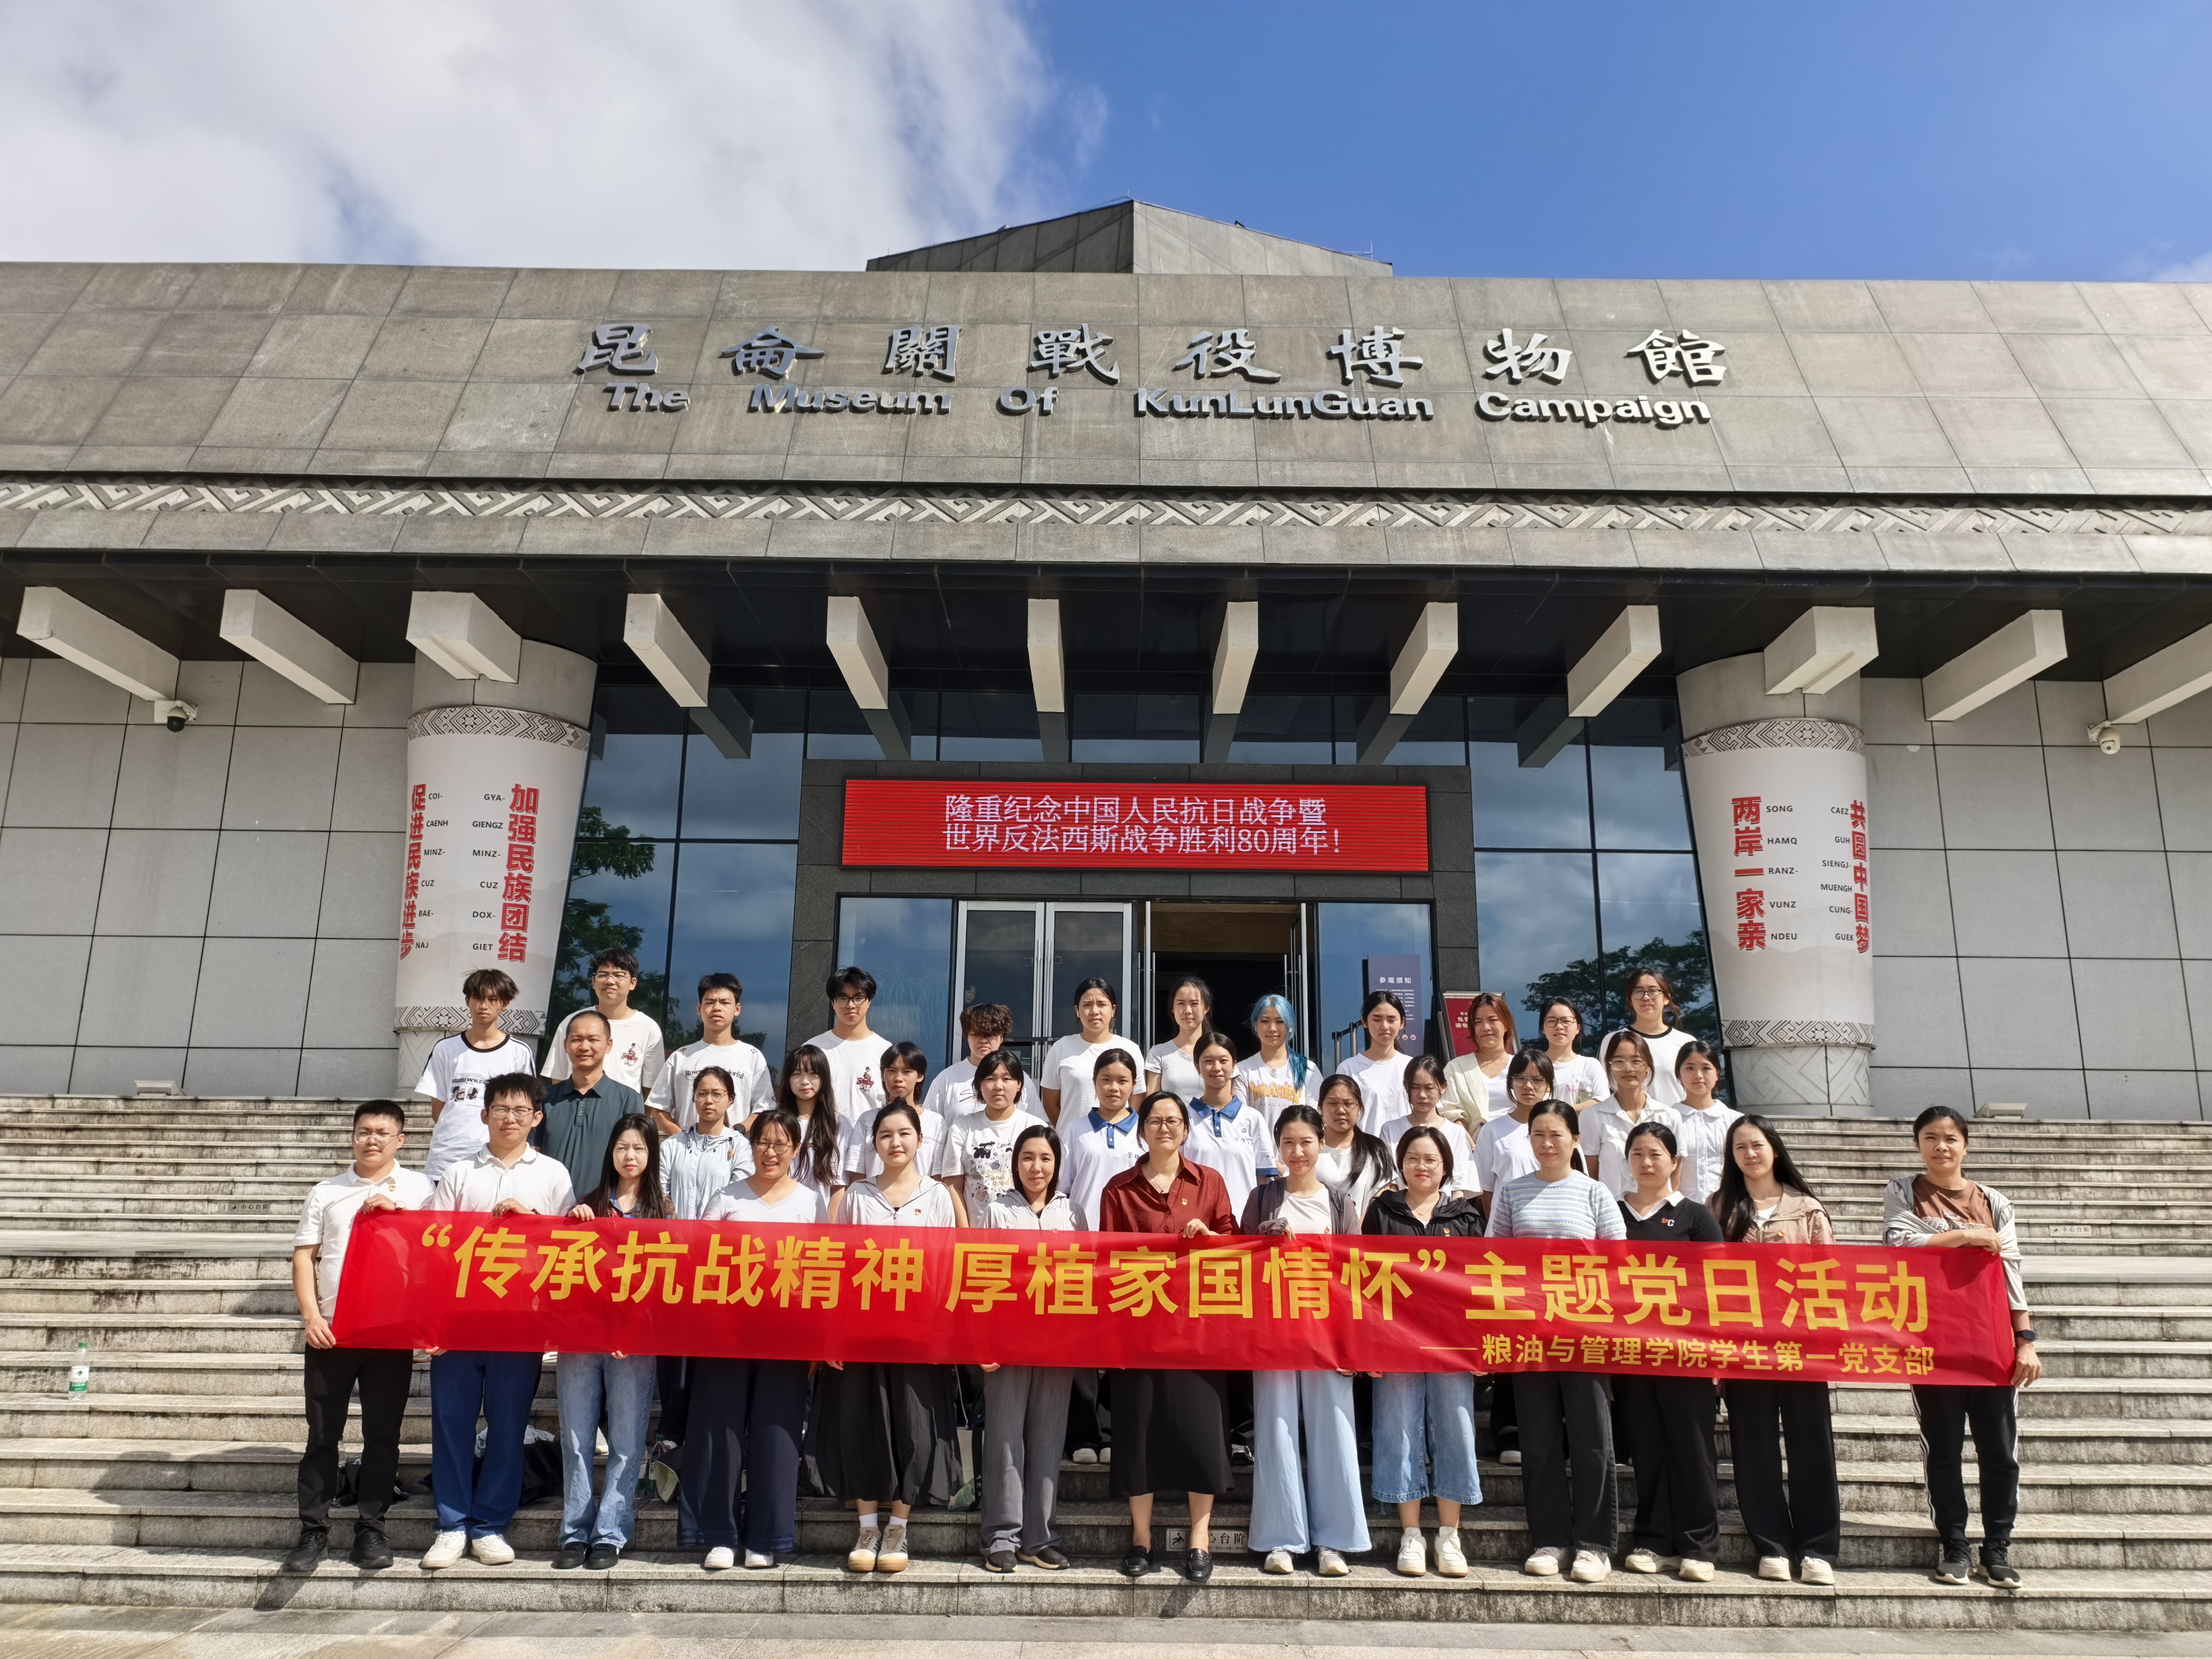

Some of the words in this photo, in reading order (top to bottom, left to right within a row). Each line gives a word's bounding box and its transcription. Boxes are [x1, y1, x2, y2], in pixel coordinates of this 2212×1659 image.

[606, 382, 690, 413] The
[749, 383, 953, 414] Museum
[996, 386, 1059, 415] Of
[1134, 387, 1434, 421] KunLunGuan
[1476, 391, 1712, 429] Campaign
[484, 793, 505, 801] GYA-
[945, 794, 1326, 825] 隆重纪念中国人民抗日战争暨
[1766, 805, 1793, 813] SONG
[473, 820, 503, 829] GIENGZ
[473, 849, 501, 858] MINZ-
[400, 784, 427, 960] 促进民族进步
[497, 784, 539, 962] 加强民族团结
[1731, 796, 1766, 950] 两岸一家亲
[1850, 799, 1869, 954] 共圆中国梦
[473, 943, 493, 951] GIET
[1209, 1532, 1245, 1545] 心台阶
